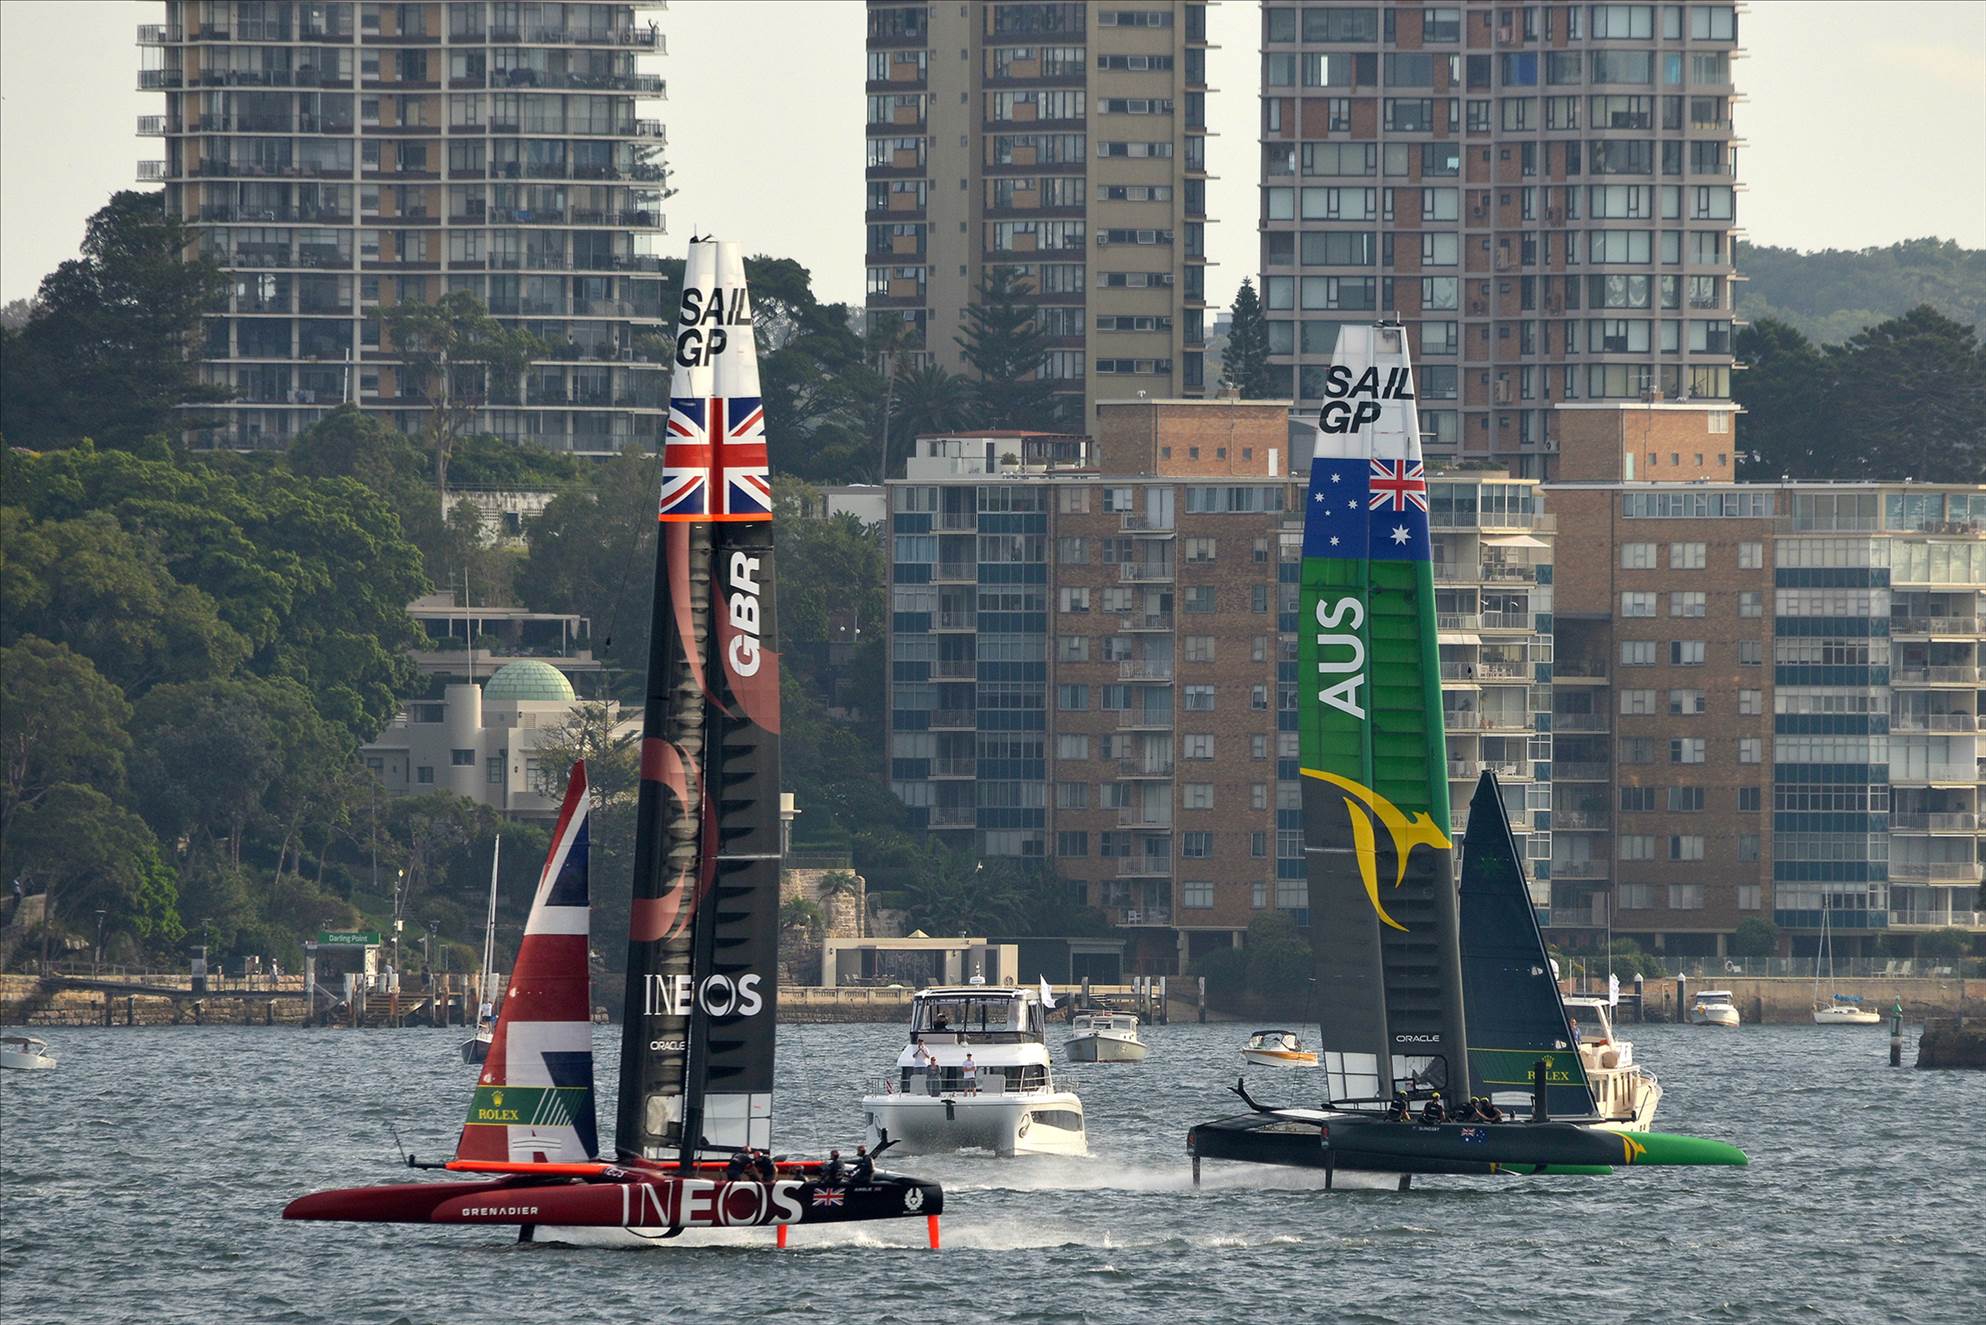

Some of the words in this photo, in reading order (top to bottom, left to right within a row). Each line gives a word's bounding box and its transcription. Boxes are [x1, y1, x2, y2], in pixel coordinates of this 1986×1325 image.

[679, 288, 752, 327] SAIL
[676, 328, 727, 367] GP
[1324, 365, 1415, 400] SAIL
[1319, 401, 1382, 434] GP
[728, 551, 760, 677] GBR
[1316, 597, 1365, 720] AUS
[329, 935, 350, 944] Darling
[643, 973, 763, 1017] INEOS
[649, 1040, 686, 1051] ORACLE
[1395, 1034, 1440, 1043] ORACLE
[1527, 1071, 1570, 1081] RLEX
[479, 1109, 519, 1120] ROLEX
[462, 1206, 539, 1216] GRENADIER
[617, 1178, 807, 1228] INEOS
